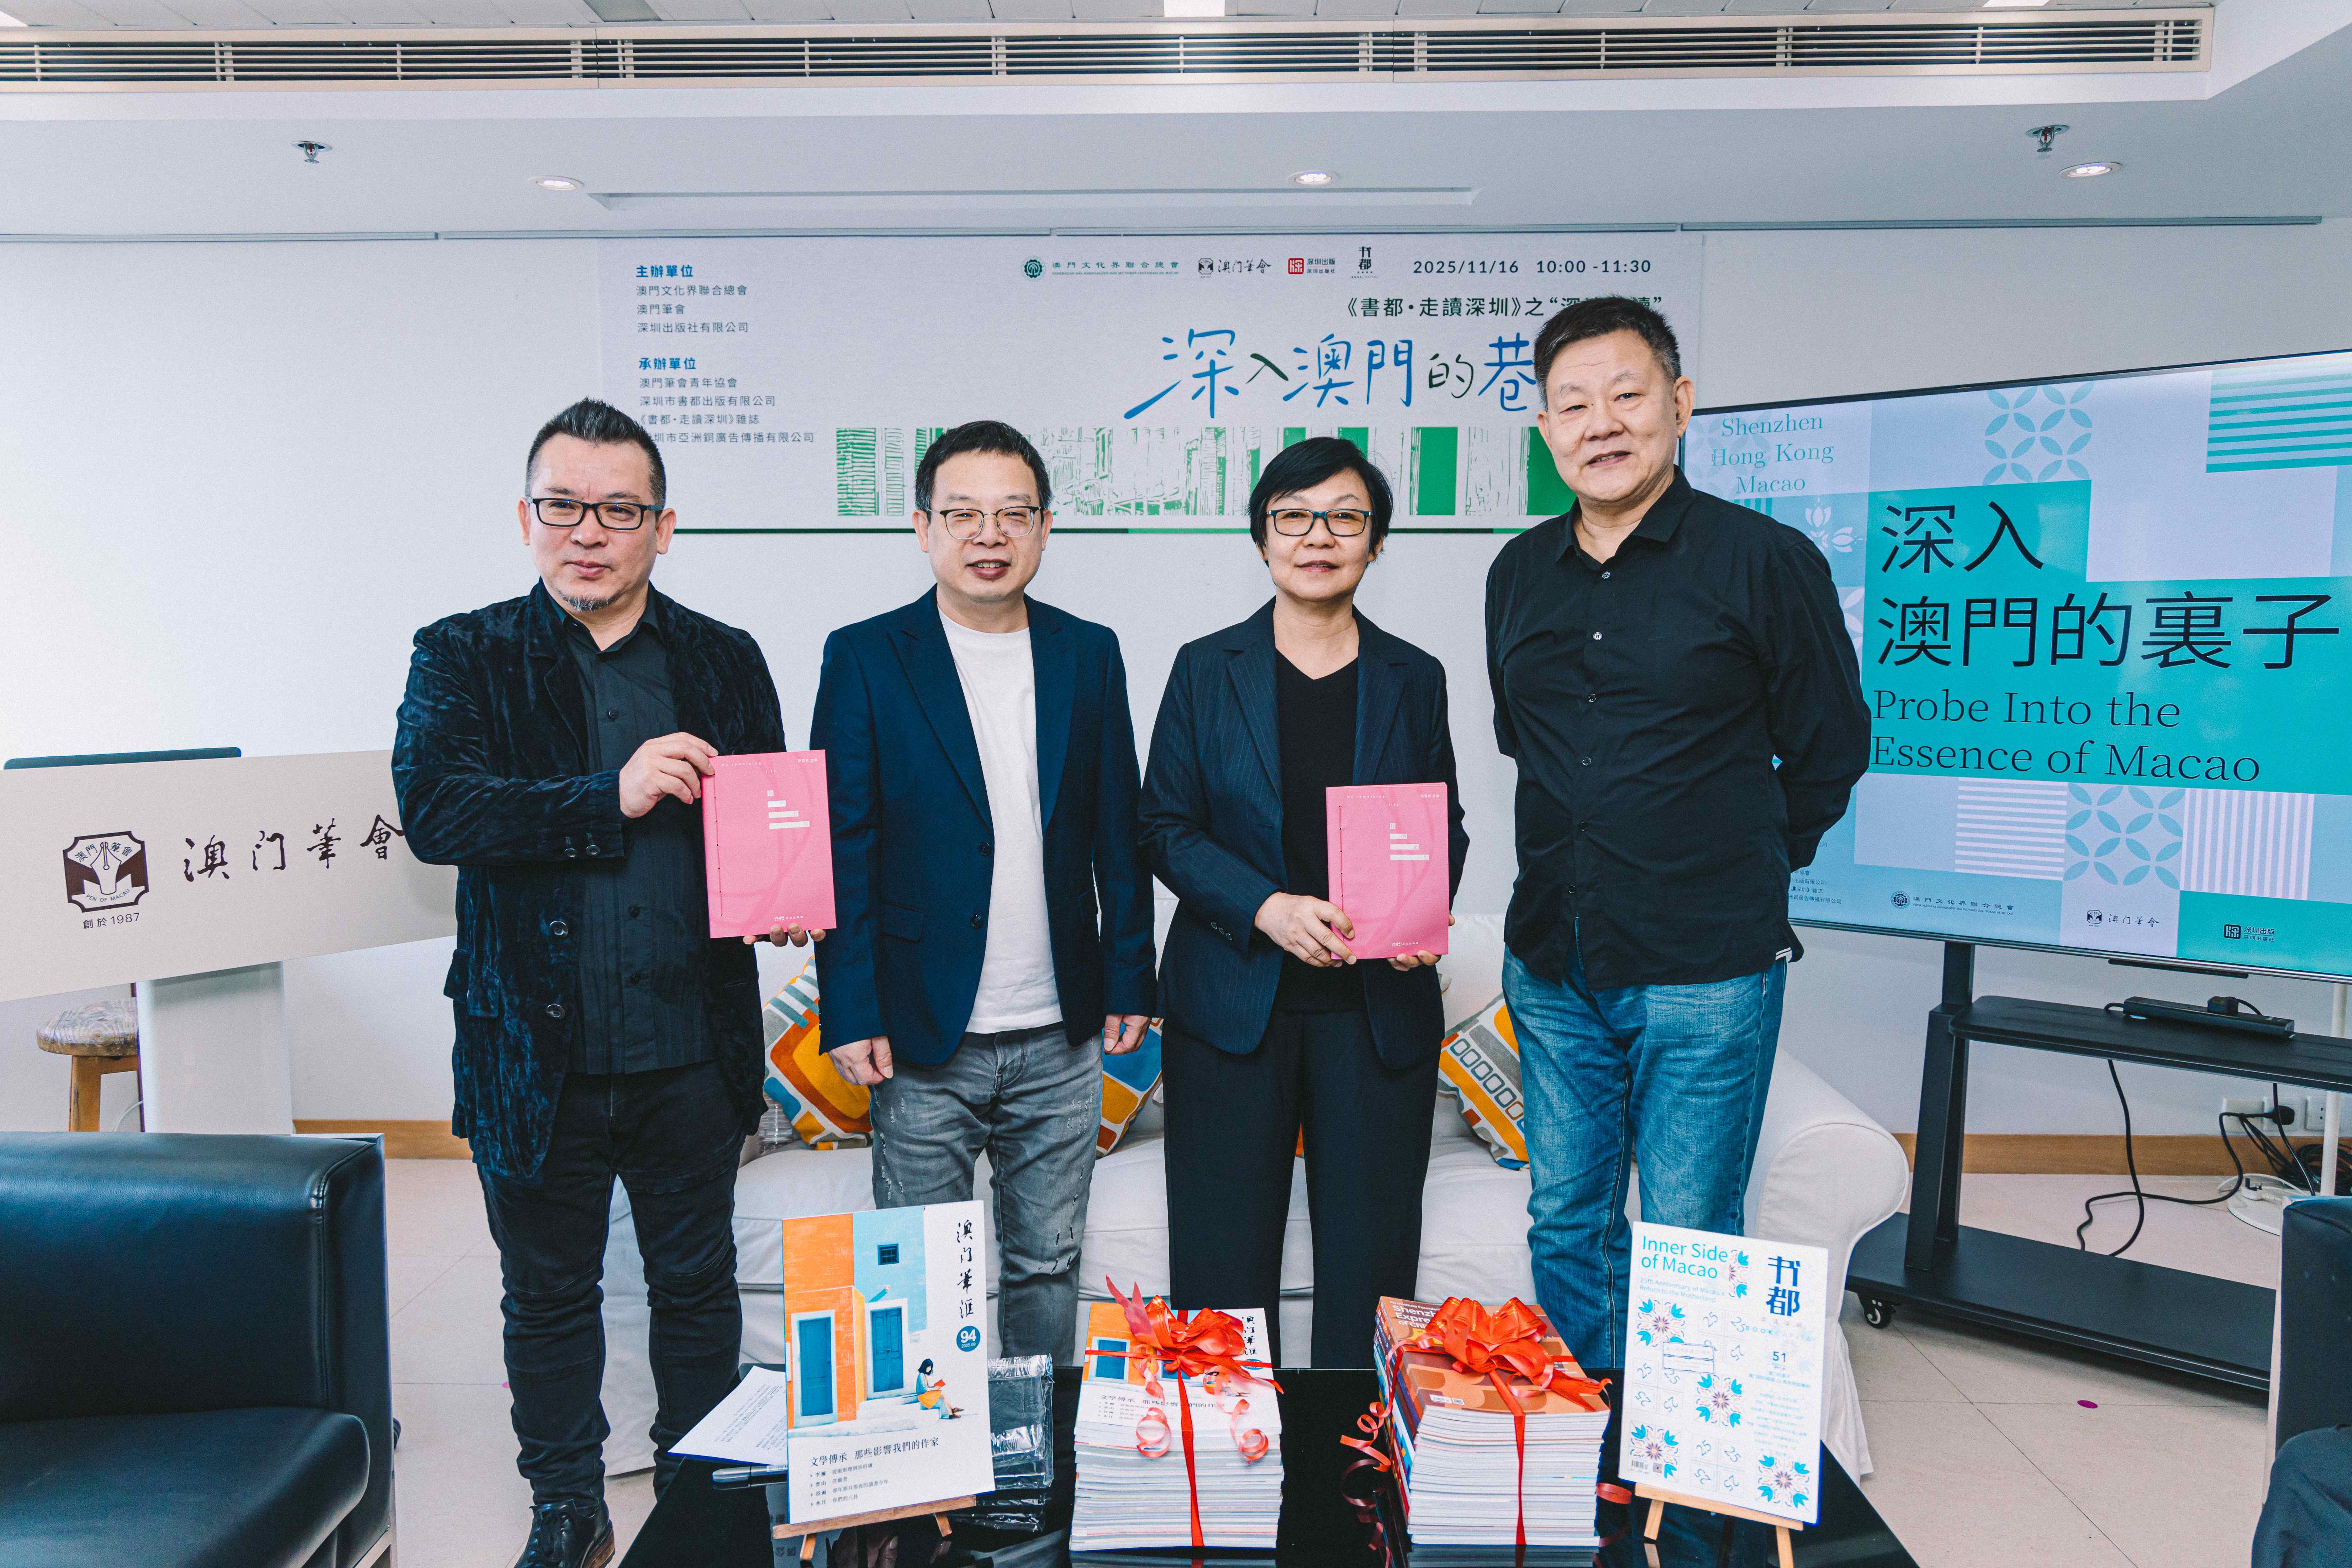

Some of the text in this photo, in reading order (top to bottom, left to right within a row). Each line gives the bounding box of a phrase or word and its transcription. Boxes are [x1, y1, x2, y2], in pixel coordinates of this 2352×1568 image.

[636, 265, 693, 278] 主辦單位
[1413, 260, 1519, 274] 2025/11/16
[1537, 260, 1586, 273] 10:00
[636, 285, 747, 296] 澳門文化界聯合總會
[637, 304, 685, 315] 澳門筆會
[638, 322, 748, 333] 深圳出版社有限公司
[639, 358, 696, 370] 承辦單位
[639, 378, 737, 388] 澳門筆會青年協會
[640, 396, 775, 407] 深圳市書都出版有限公司
[1722, 414, 1823, 437] Shenzhen
[651, 432, 813, 443] 圳市亞洲銅廣告傳播有限公司
[1711, 443, 1834, 468] Hong Kong
[1736, 475, 1805, 494] Macao
[1882, 501, 2044, 574] 深入
[1877, 591, 2340, 669] 澳門的裏子
[1873, 689, 2180, 728] Probe Into the
[1871, 736, 2260, 782] Essence of Macao
[110, 888, 131, 901] MACAU
[2244, 926, 2274, 935] 深圳出版
[1643, 1235, 1728, 1262] Inner Side
[1641, 1254, 1718, 1278] of Macao
[1703, 1311, 1718, 1327] 25
[1731, 1317, 1746, 1332] 25
[960, 1329, 977, 1343] 94
[1772, 1351, 1786, 1363] 51
[1637, 1363, 1652, 1379] 25
[811, 1437, 939, 1467] 文學傳承 那些影響我們的作家
[1696, 1440, 1711, 1456] 25
[1724, 1446, 1741, 1462] 25
